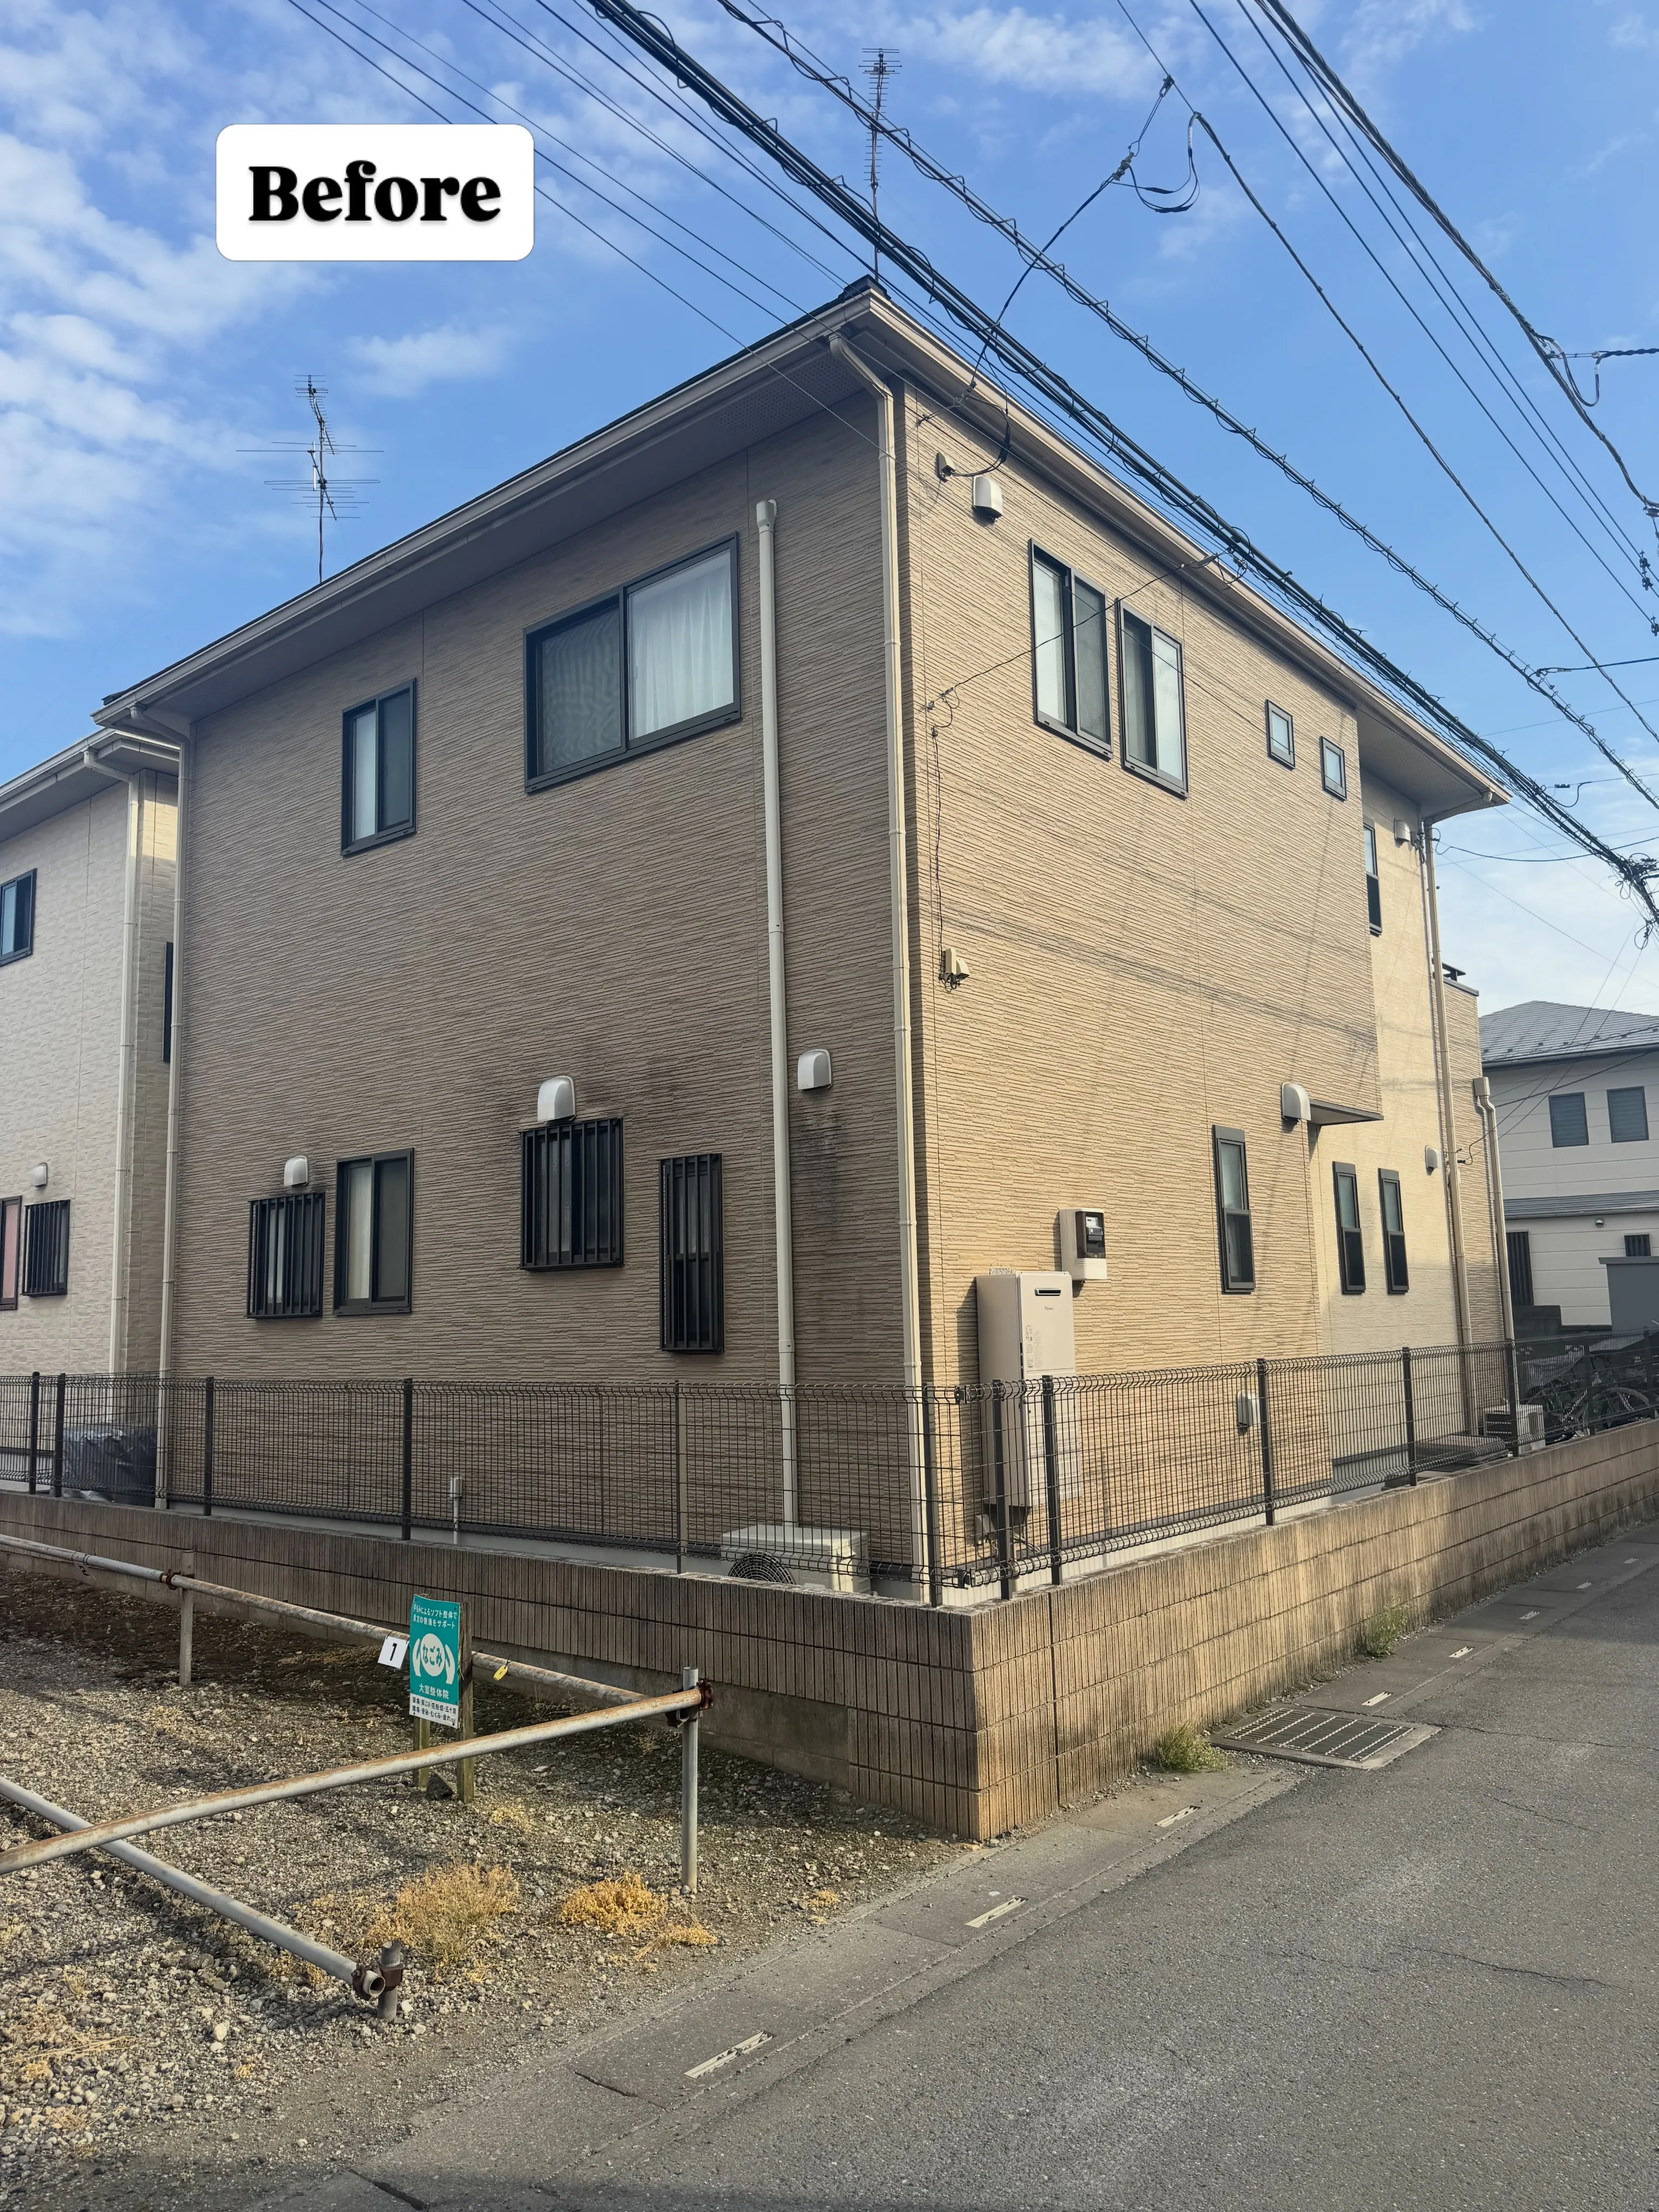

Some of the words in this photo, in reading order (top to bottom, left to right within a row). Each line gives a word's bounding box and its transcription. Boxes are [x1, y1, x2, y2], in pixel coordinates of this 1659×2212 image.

[79, 1565, 89, 1576] 2
[389, 1642, 397, 1661] 1
[422, 1643, 442, 1668] なごみ
[419, 1683, 449, 1700] 大室整体院
